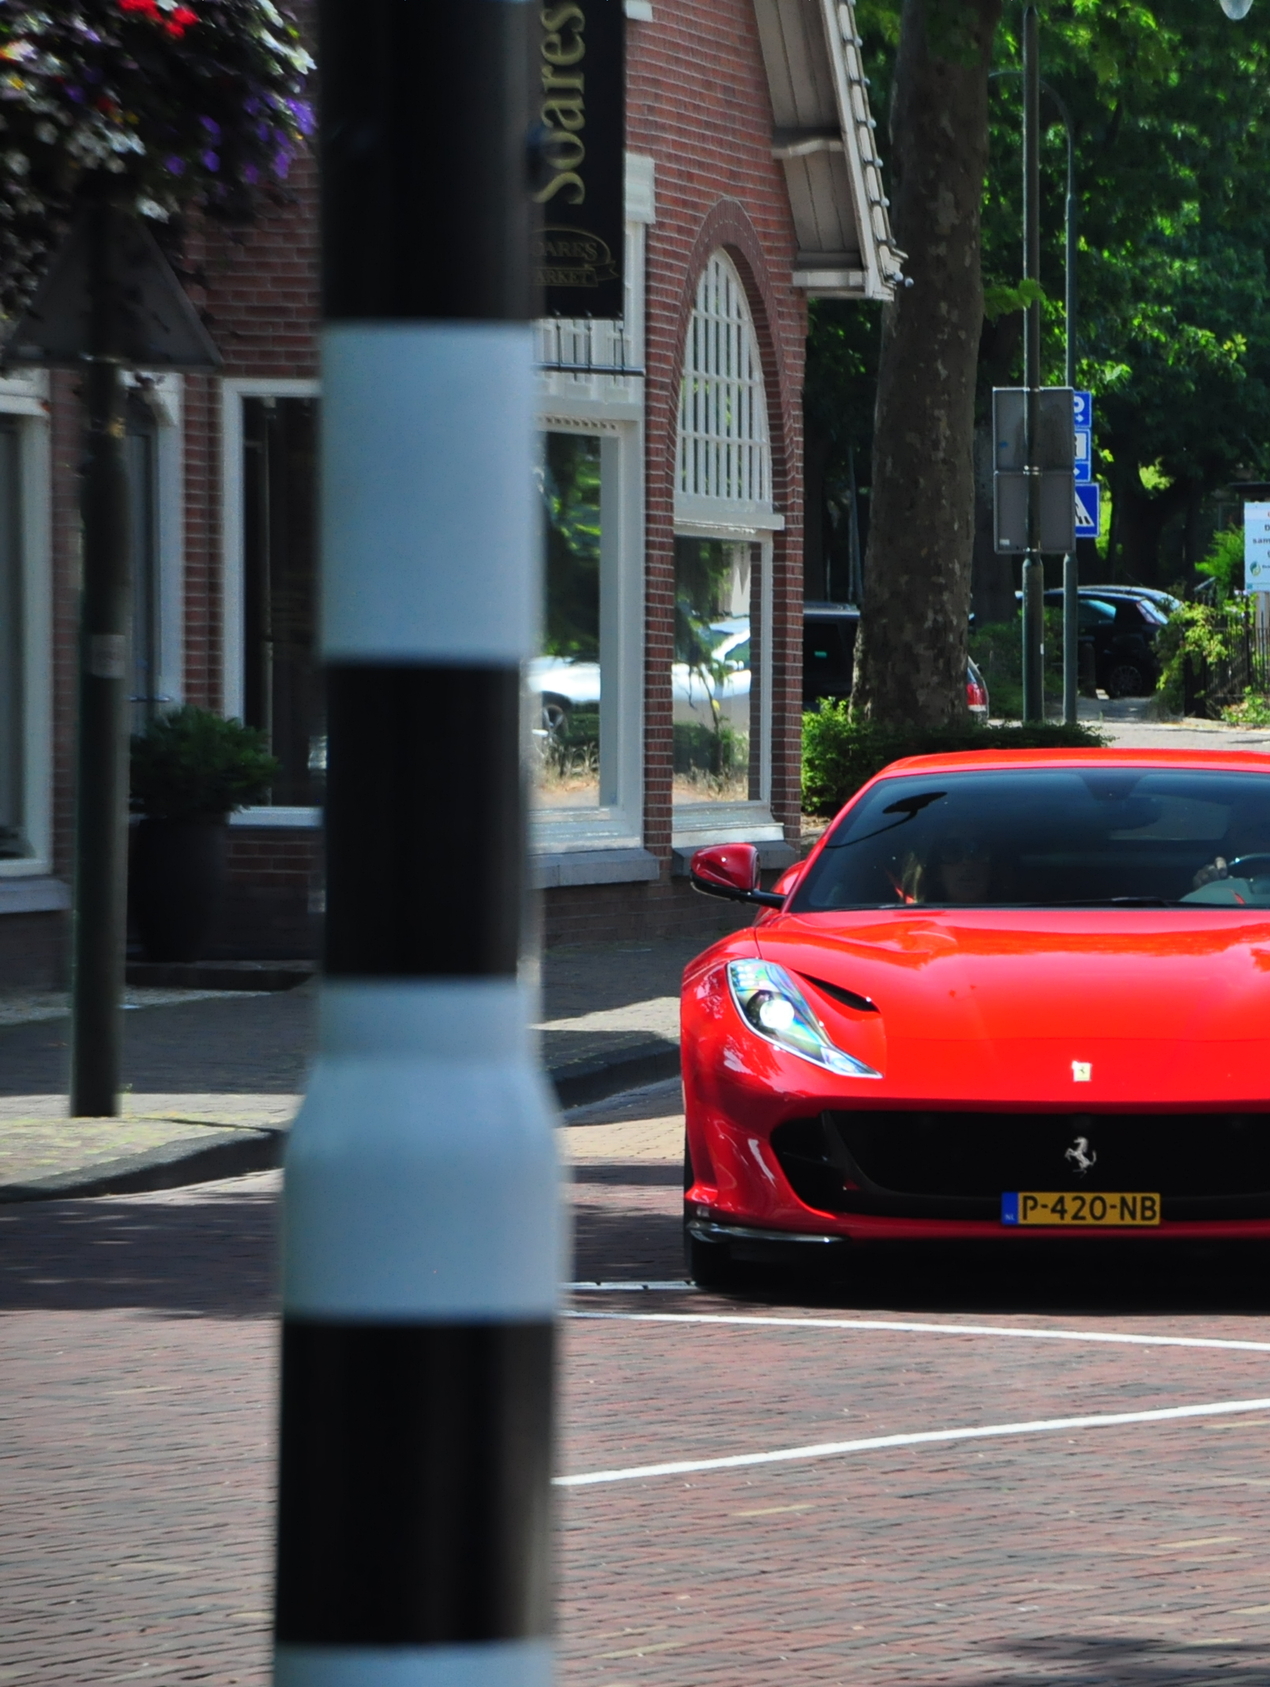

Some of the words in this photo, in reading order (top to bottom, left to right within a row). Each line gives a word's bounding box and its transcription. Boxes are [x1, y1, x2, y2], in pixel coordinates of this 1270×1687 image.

[532, 3, 586, 205] Soares
[530, 240, 598, 262] OARES
[533, 270, 591, 284] ARKET
[1005, 1213, 1015, 1221] NL
[1022, 1195, 1157, 1221] P-420-NB
